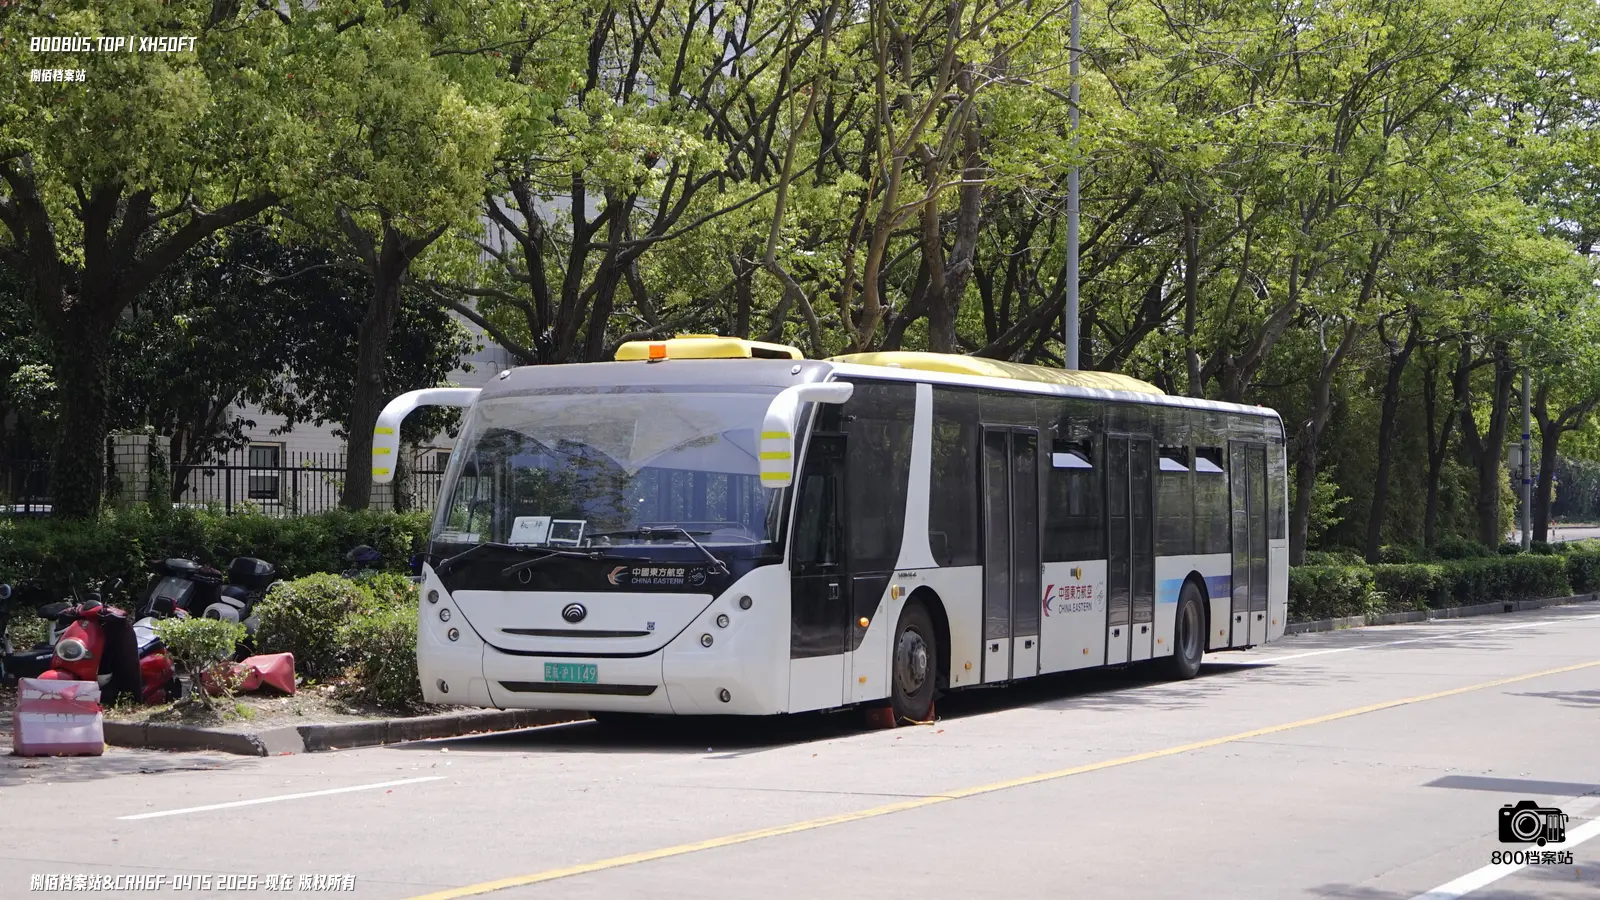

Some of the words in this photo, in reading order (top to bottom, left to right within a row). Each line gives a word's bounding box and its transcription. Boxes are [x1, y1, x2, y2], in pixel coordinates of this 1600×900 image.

[632, 567, 685, 577] 中國東方航空
[653, 577, 684, 585] EASTERN
[1058, 585, 1093, 600] 中國東方航空
[1058, 603, 1072, 614] CHINA
[1072, 602, 1093, 612] EASTERN
